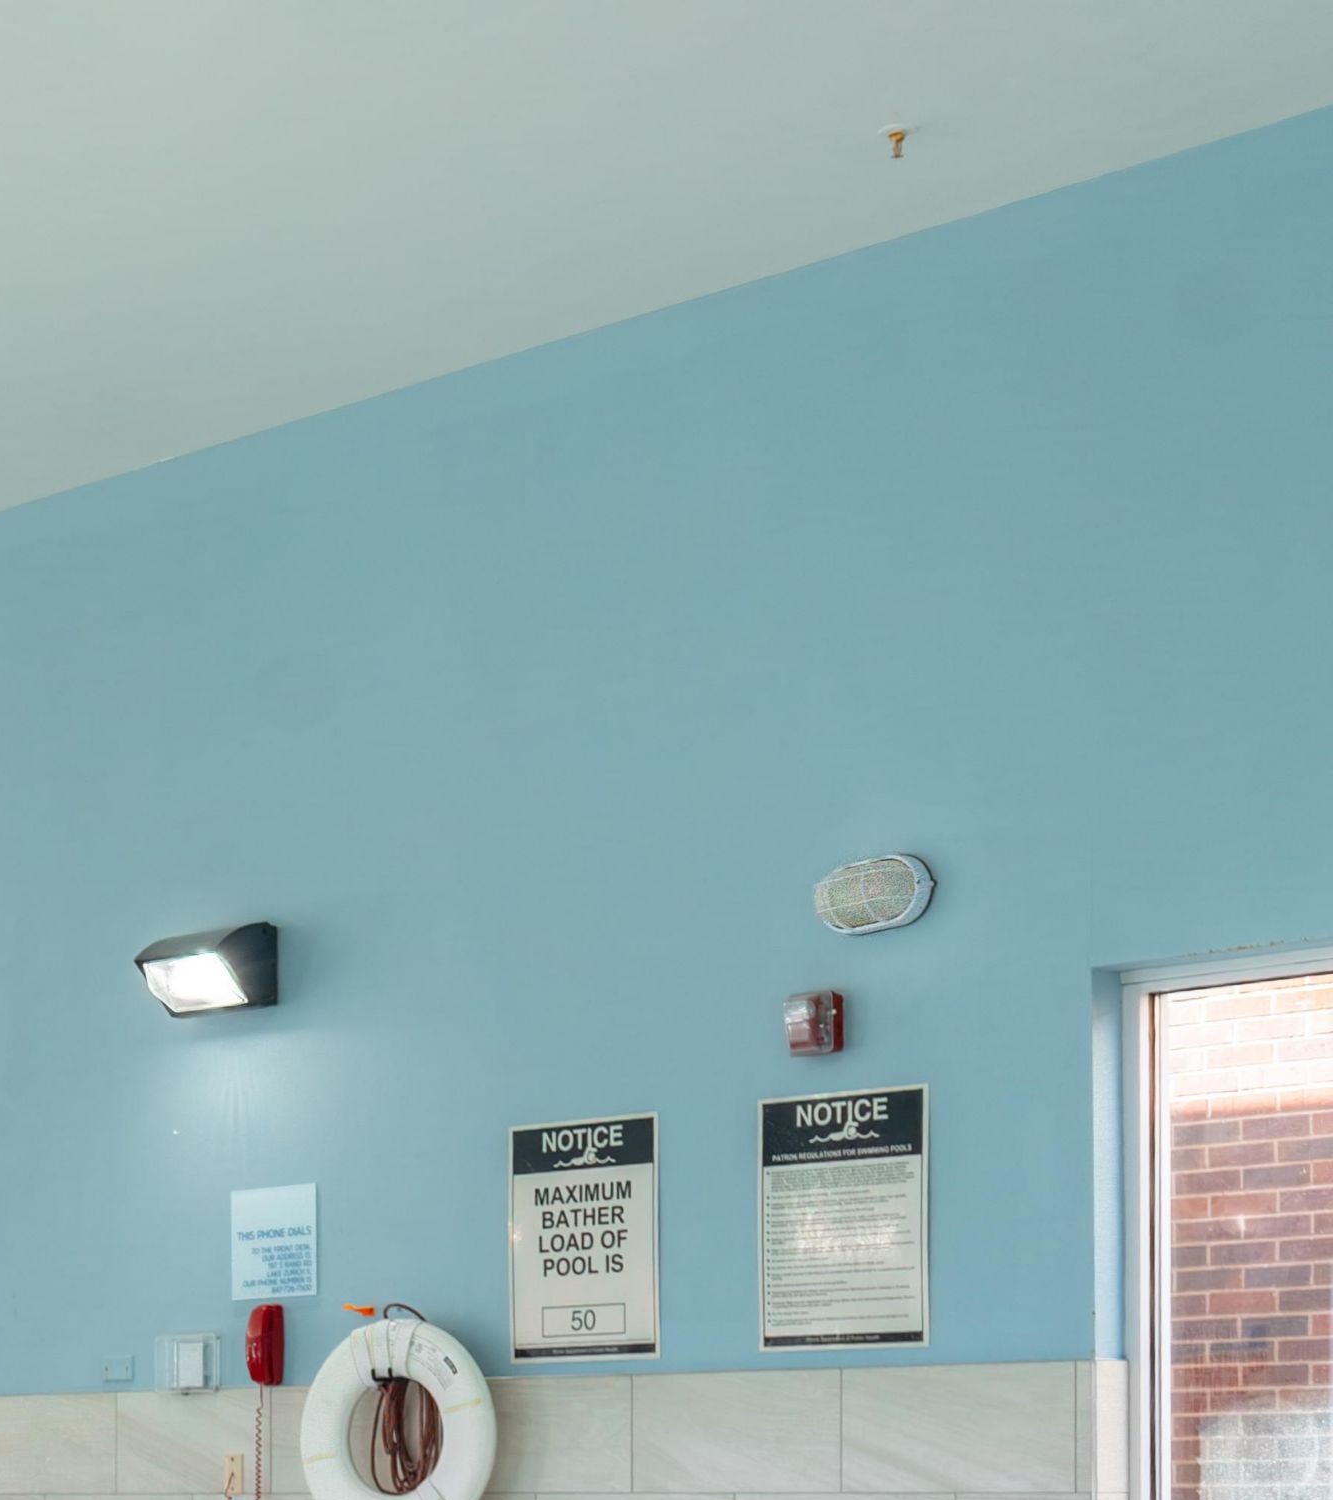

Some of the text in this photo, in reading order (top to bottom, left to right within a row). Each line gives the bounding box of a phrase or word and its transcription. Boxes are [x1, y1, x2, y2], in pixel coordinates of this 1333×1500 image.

[796, 1097, 889, 1128] NOTICE
[541, 1124, 624, 1154] NOTICE
[772, 1153, 798, 1162] PATRON
[798, 1149, 842, 1161] REGULATIONS
[843, 1148, 856, 1157] FOR
[890, 1143, 912, 1153] POOLS
[534, 1180, 632, 1207] MAXIMUM
[542, 1205, 625, 1230] BATHER
[236, 1225, 312, 1241] THIS PHONE DIALS
[538, 1229, 628, 1253] LOAD OF
[543, 1253, 624, 1277] POOL IS
[570, 1309, 596, 1331] 50
